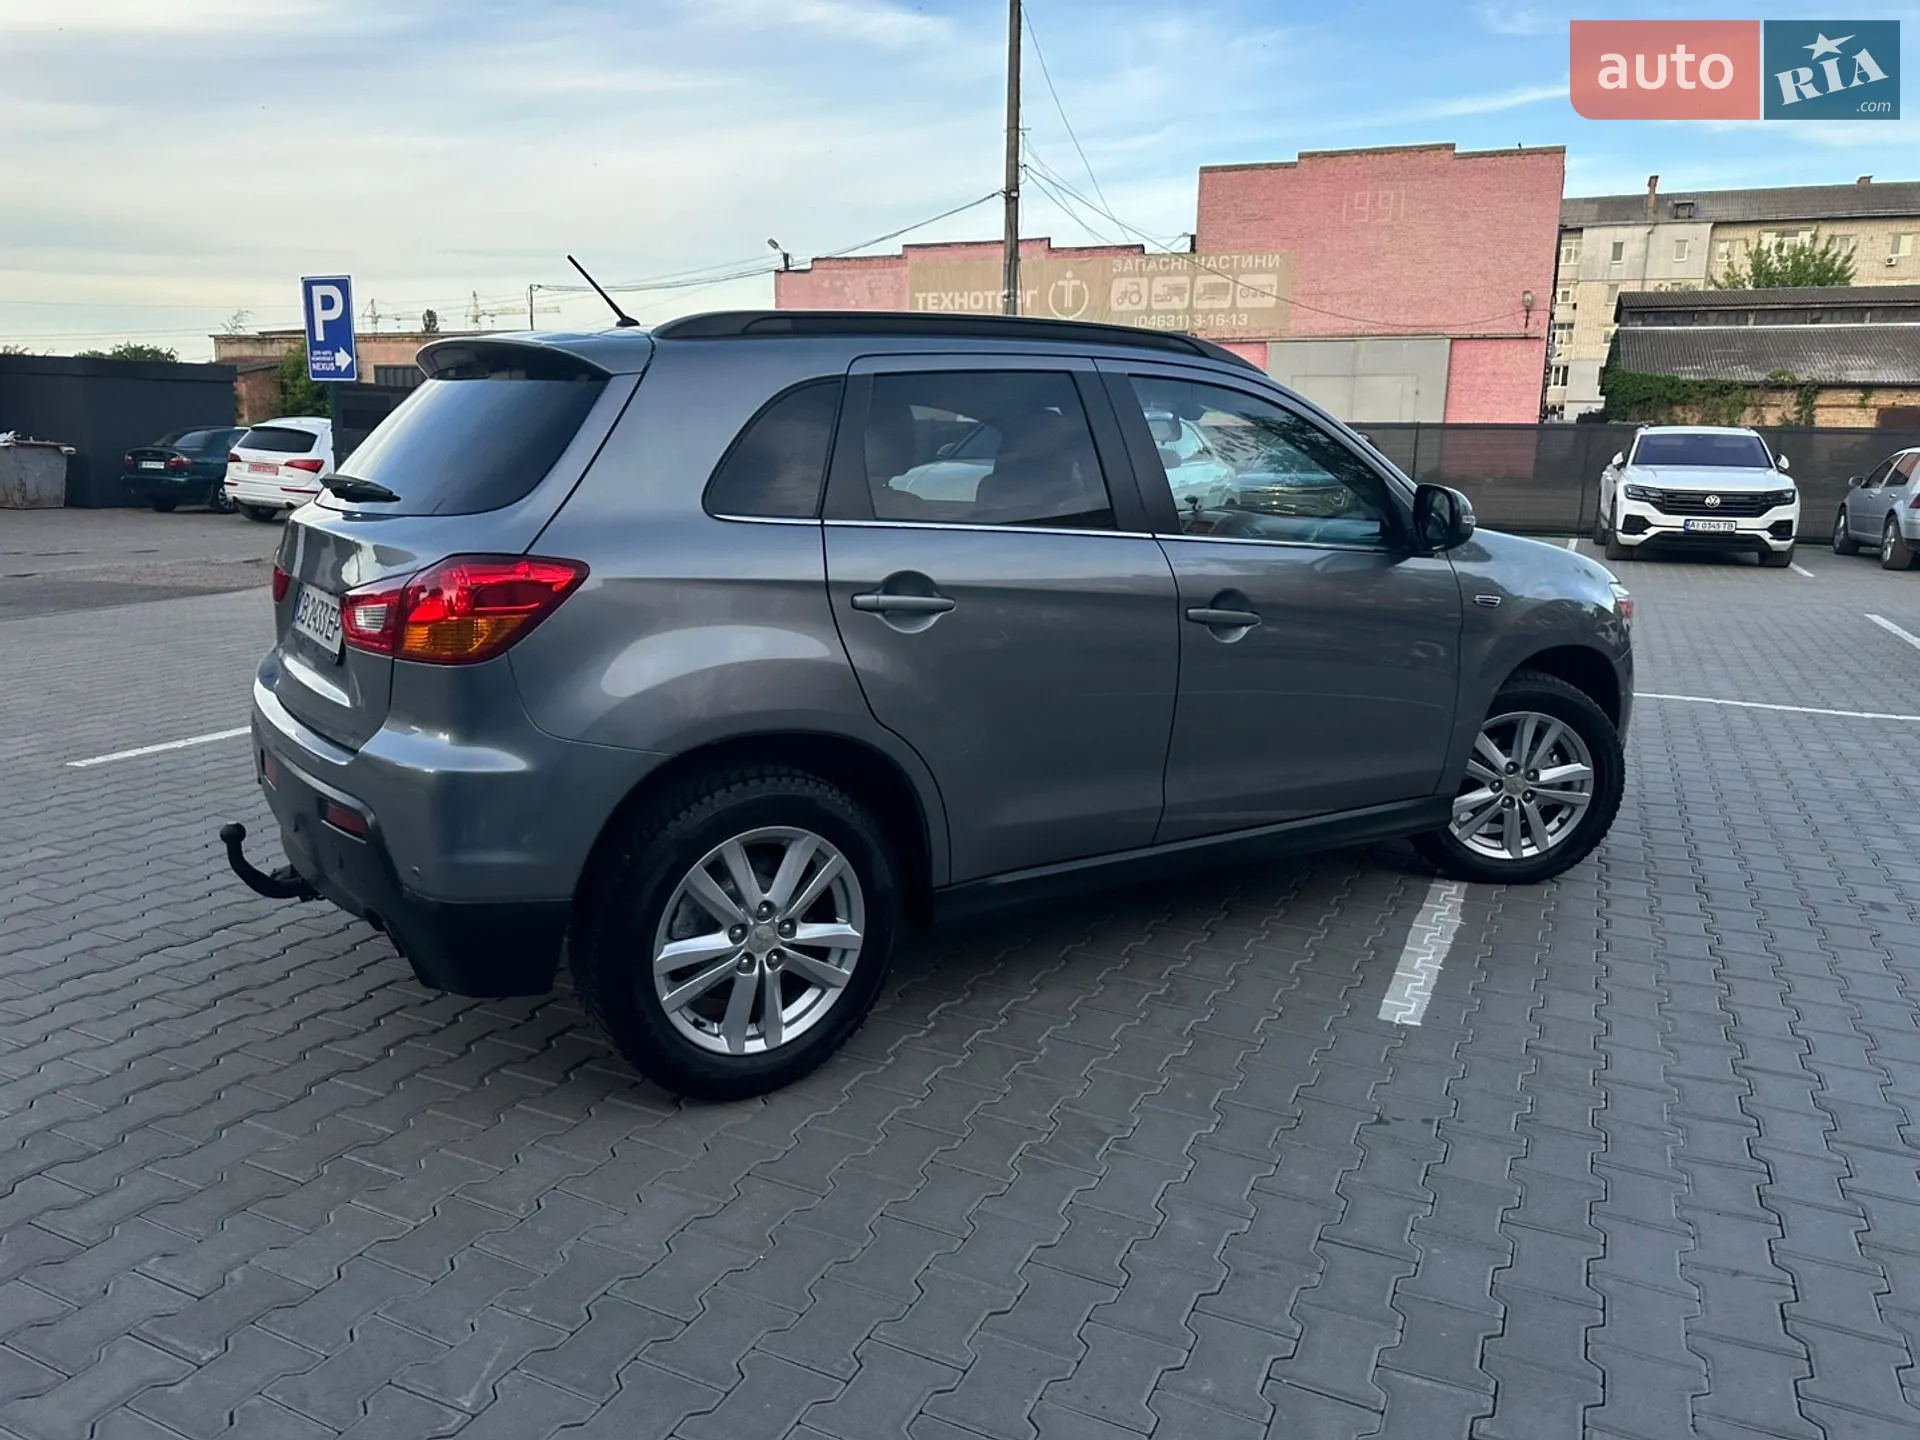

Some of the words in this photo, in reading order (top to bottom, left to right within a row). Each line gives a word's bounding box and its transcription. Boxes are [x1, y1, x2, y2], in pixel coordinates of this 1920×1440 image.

[1112, 257, 1188, 274] ЗАПАСНІ
[1195, 254, 1281, 271] ЧАСТИНИ
[311, 285, 344, 341] P
[1134, 314, 1190, 329] (04631)
